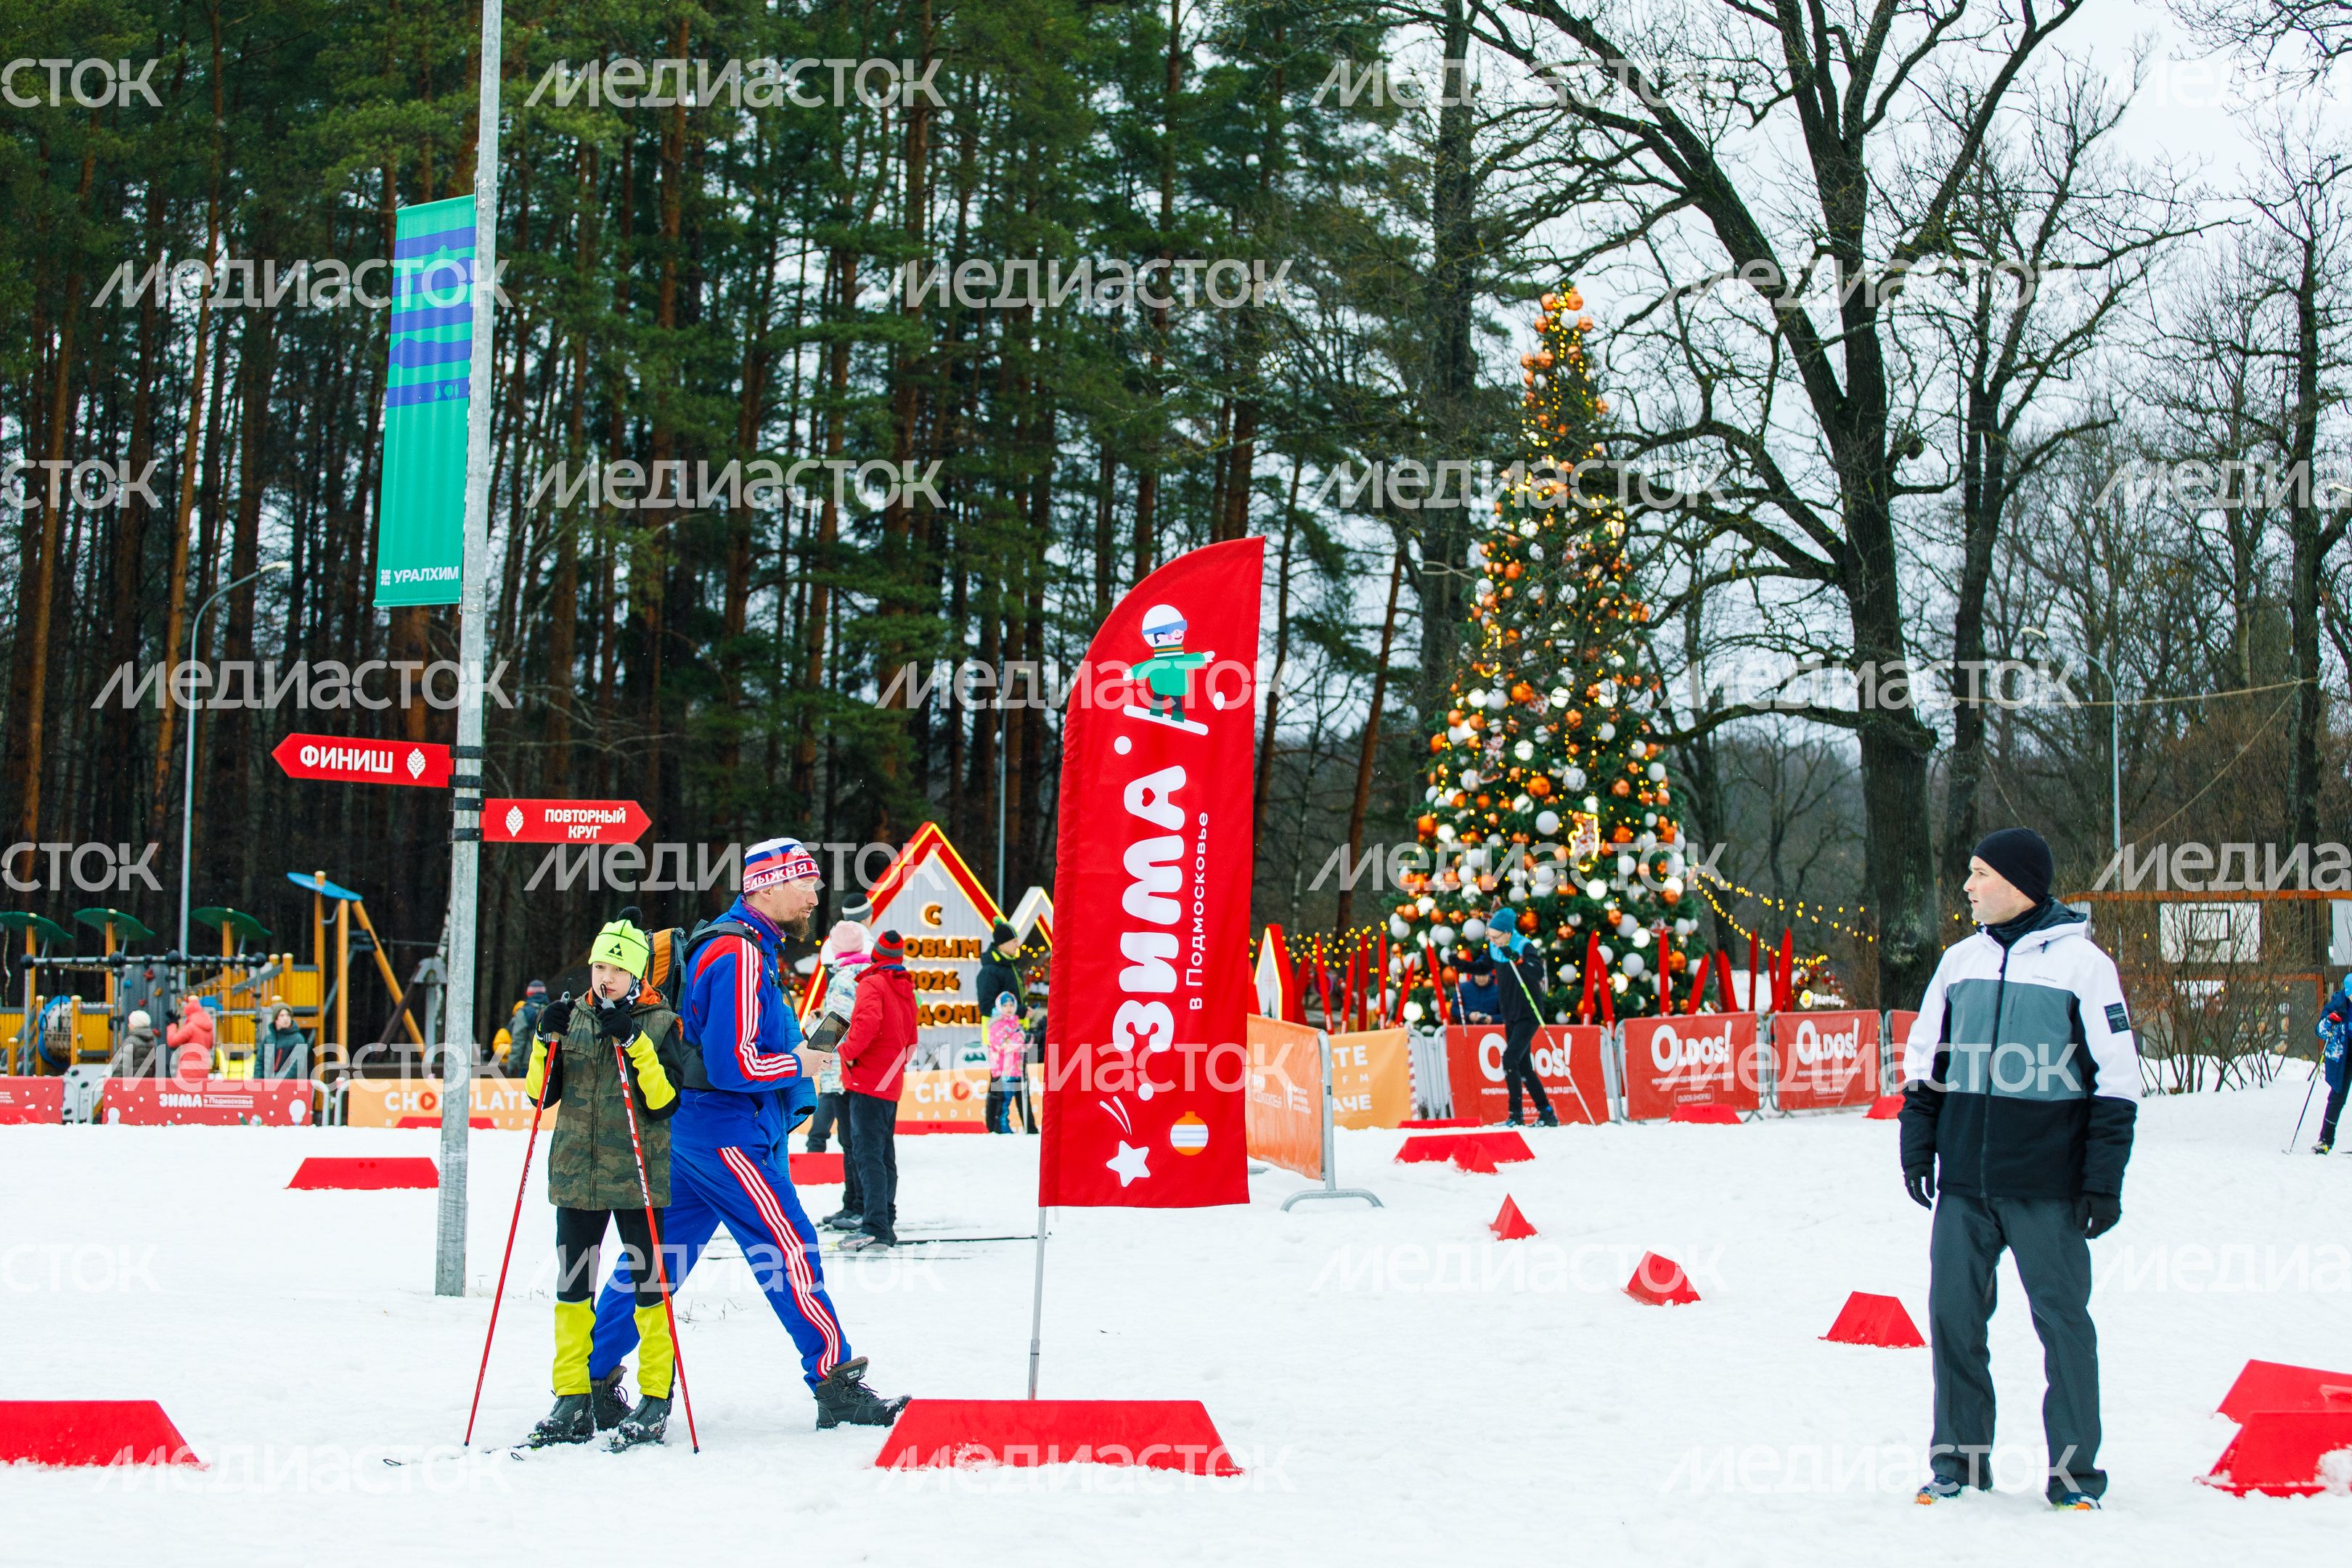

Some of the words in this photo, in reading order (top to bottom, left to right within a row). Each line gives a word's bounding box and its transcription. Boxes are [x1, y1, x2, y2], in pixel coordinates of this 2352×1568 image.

[393, 565, 460, 584] УРАЛХИМ
[299, 745, 394, 774] ФИНИШ
[544, 807, 626, 825] ПОВТОРНЫЙ
[568, 825, 602, 840] КРУГ
[751, 863, 807, 888] ЛЫЖНЯ
[1112, 765, 1187, 1053] ЗИМА
[1185, 812, 1209, 987] Подмосковье
[903, 938, 982, 958] ОВЫМ
[1189, 997, 1203, 1010] в
[1651, 1020, 1733, 1072] OLDOS!
[1796, 1017, 1860, 1065] OLDOS!
[1478, 1032, 1572, 1082] OOS!
[159, 1093, 203, 1108] ЗИМА
